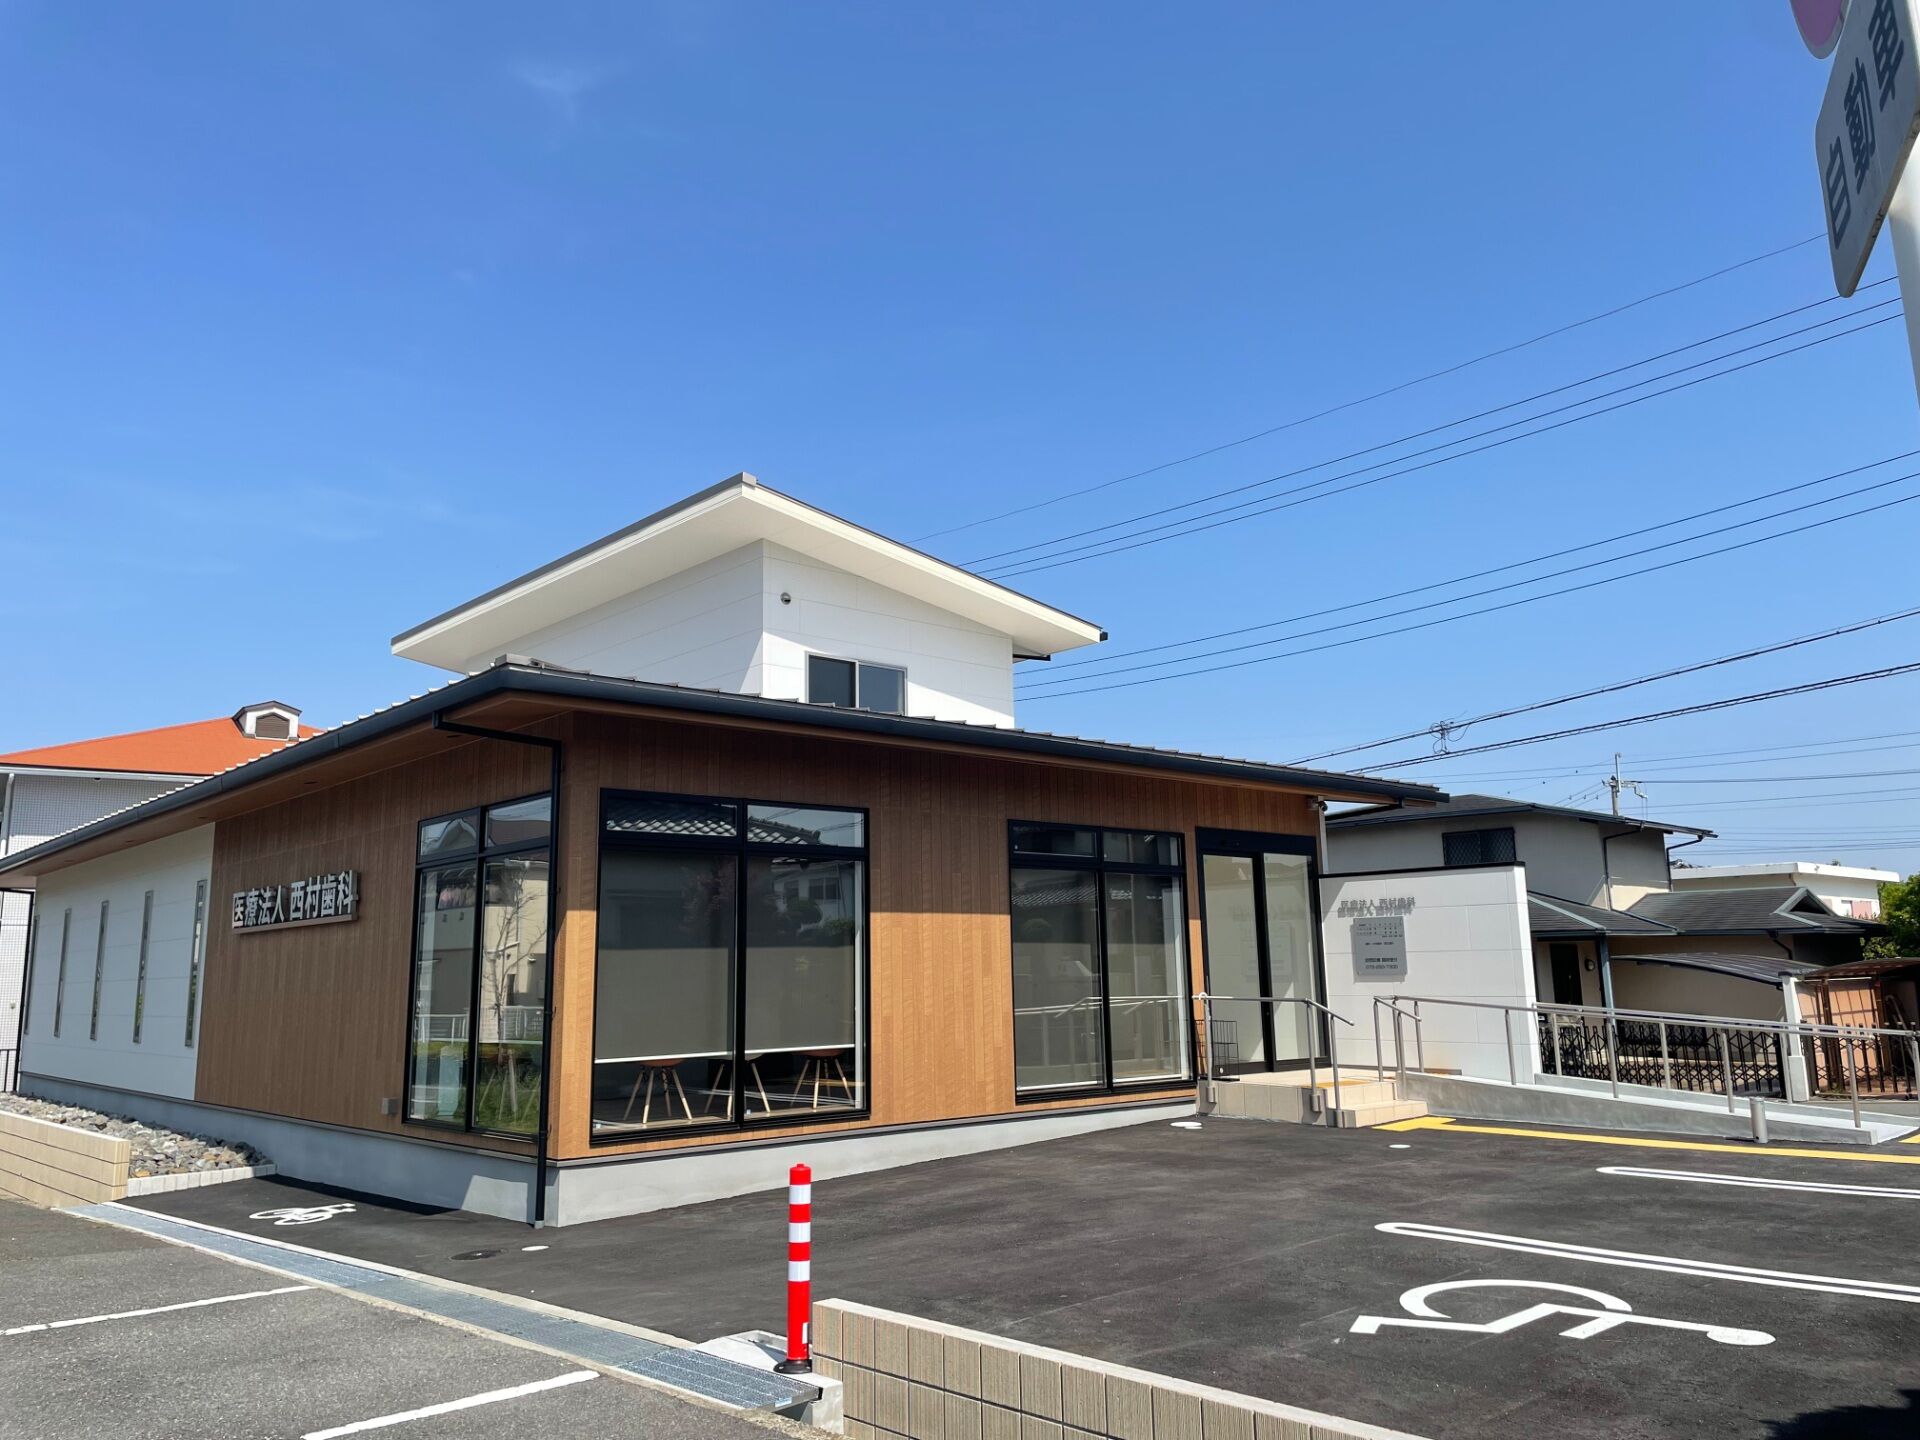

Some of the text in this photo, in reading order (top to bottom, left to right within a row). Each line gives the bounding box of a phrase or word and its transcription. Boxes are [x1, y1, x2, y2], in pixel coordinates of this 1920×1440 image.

[231, 870, 358, 929] 医療法人 西村歯科
